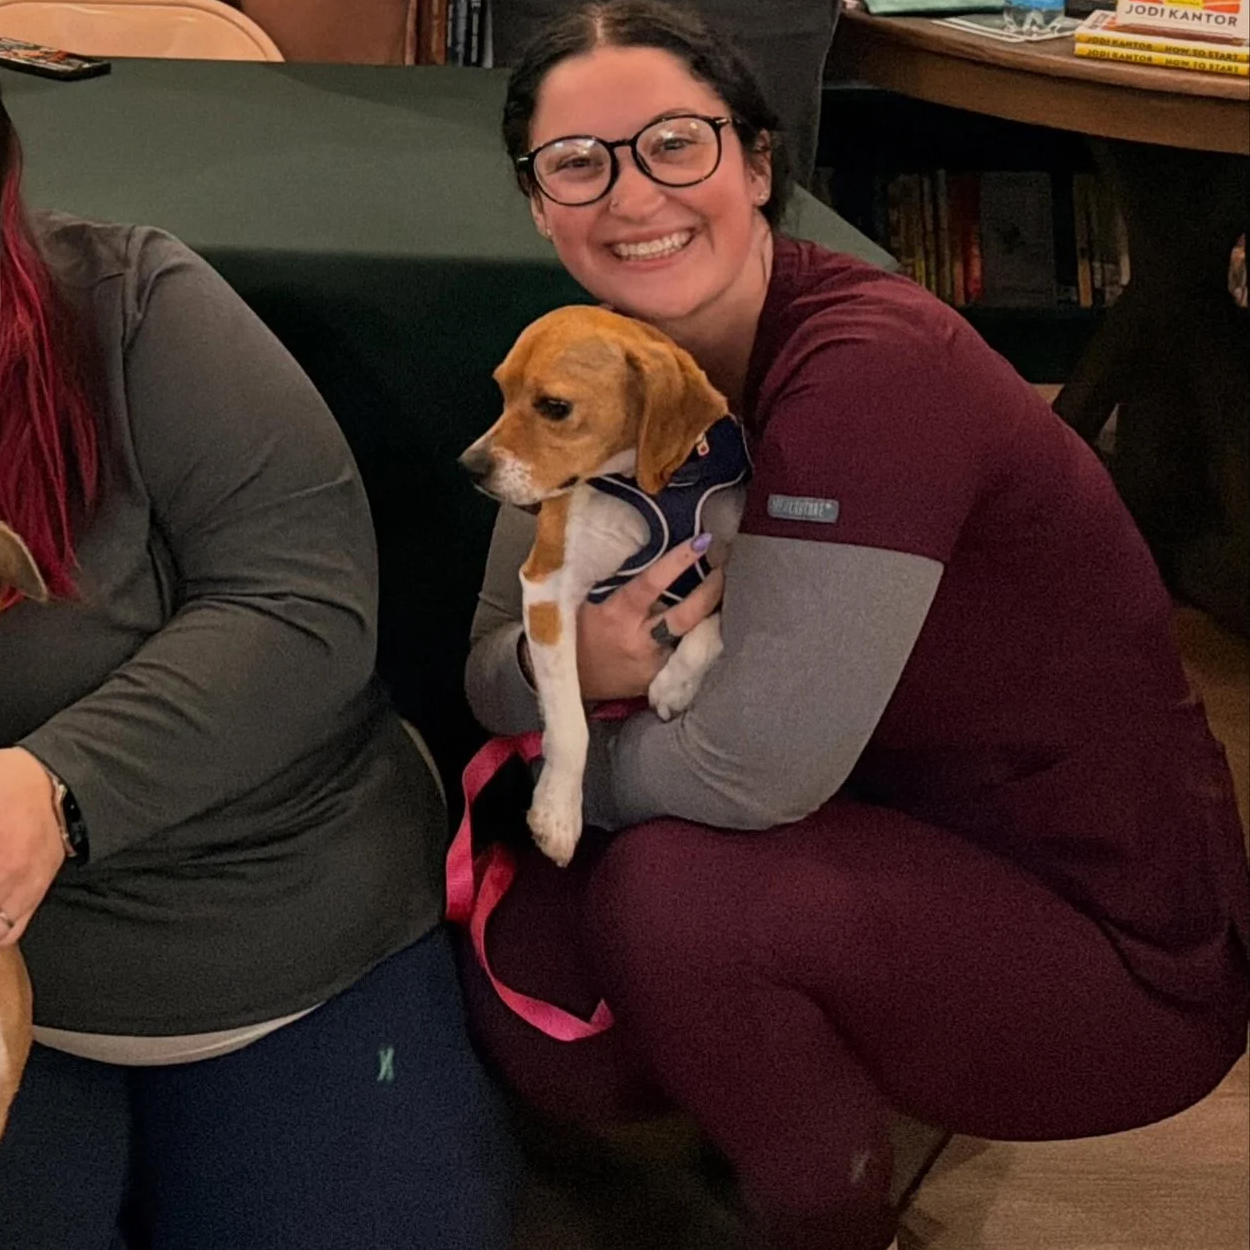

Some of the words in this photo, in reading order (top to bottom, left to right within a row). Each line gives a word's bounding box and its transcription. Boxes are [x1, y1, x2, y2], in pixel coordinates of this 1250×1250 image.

[1125, 3, 1165, 18] JODI
[1168, 8, 1239, 27] KANTOR
[1085, 36, 1110, 45] JODI
[1112, 38, 1154, 51] KANTOR
[1165, 45, 1188, 55] HOW
[1192, 47, 1207, 56] TO
[1208, 50, 1239, 62] START
[1086, 49, 1110, 58] JODI
[1112, 51, 1153, 63] KANTOR
[1164, 58, 1188, 68] HOW
[1192, 61, 1207, 70] TO
[1208, 62, 1239, 73] START
